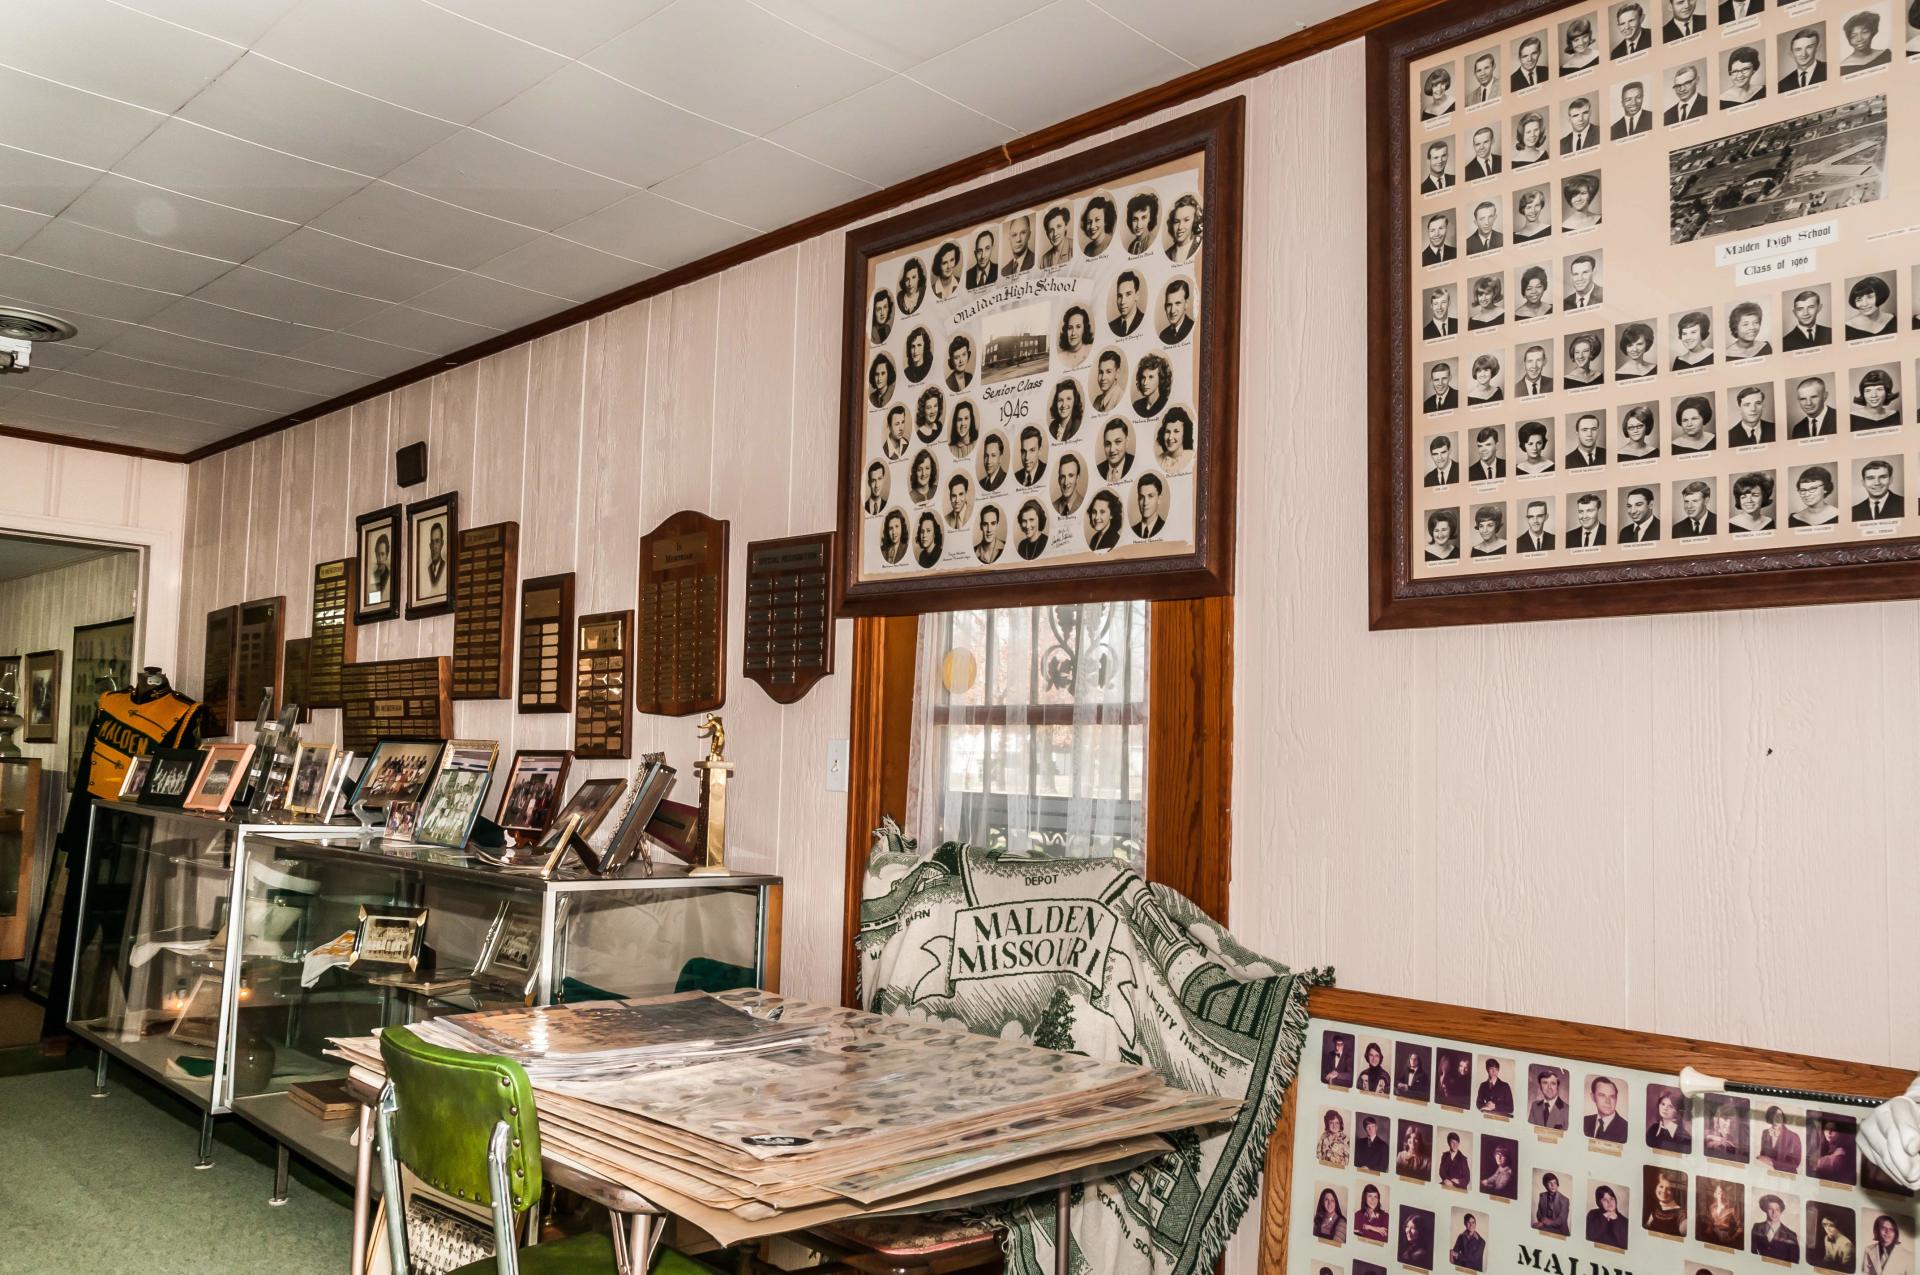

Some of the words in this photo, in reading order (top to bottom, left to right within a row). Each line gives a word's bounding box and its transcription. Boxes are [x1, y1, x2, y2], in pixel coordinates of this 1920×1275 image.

[1798, 226, 1831, 241] School
[1744, 263, 1771, 276] Class
[1777, 259, 1785, 270] of
[1791, 256, 1808, 267] 1966
[1002, 281, 1033, 301] High
[1034, 278, 1077, 296] School
[982, 384, 1016, 400] Senior
[1017, 379, 1044, 392] Class
[999, 397, 1029, 427] 1946
[98, 720, 149, 756] MALDEN
[1025, 874, 1058, 887] DEPOT
[905, 909, 931, 927] BARN
[973, 906, 1104, 943] MALDEN
[958, 937, 1101, 977] MISSOURI
[1179, 1031, 1228, 1080] THEATRE
[1096, 1189, 1131, 1240] ECKWITH
